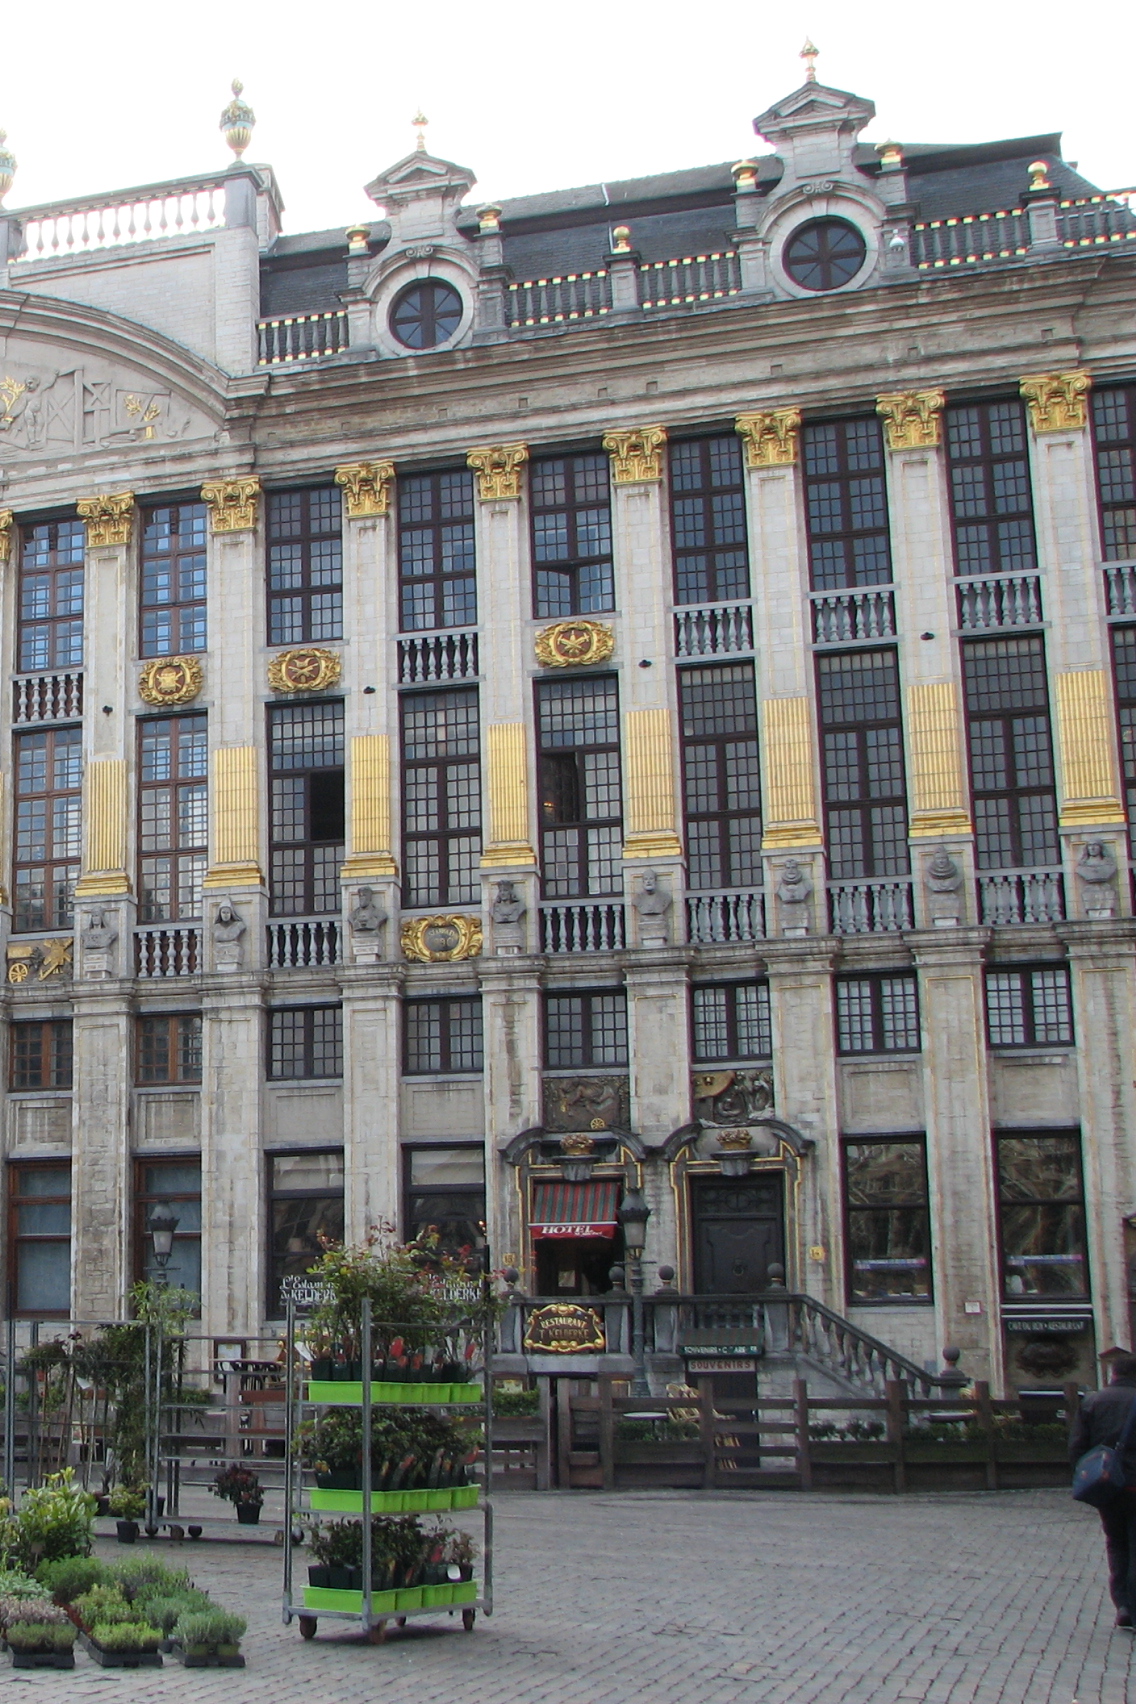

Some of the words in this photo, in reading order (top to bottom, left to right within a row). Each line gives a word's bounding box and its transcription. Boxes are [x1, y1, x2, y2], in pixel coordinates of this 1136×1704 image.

[541, 1225, 593, 1234] HOTEL
[539, 1316, 587, 1329] RESTAURANT
[548, 1329, 589, 1339] KELDERKE
[690, 1360, 752, 1370] SOUVENIRS
